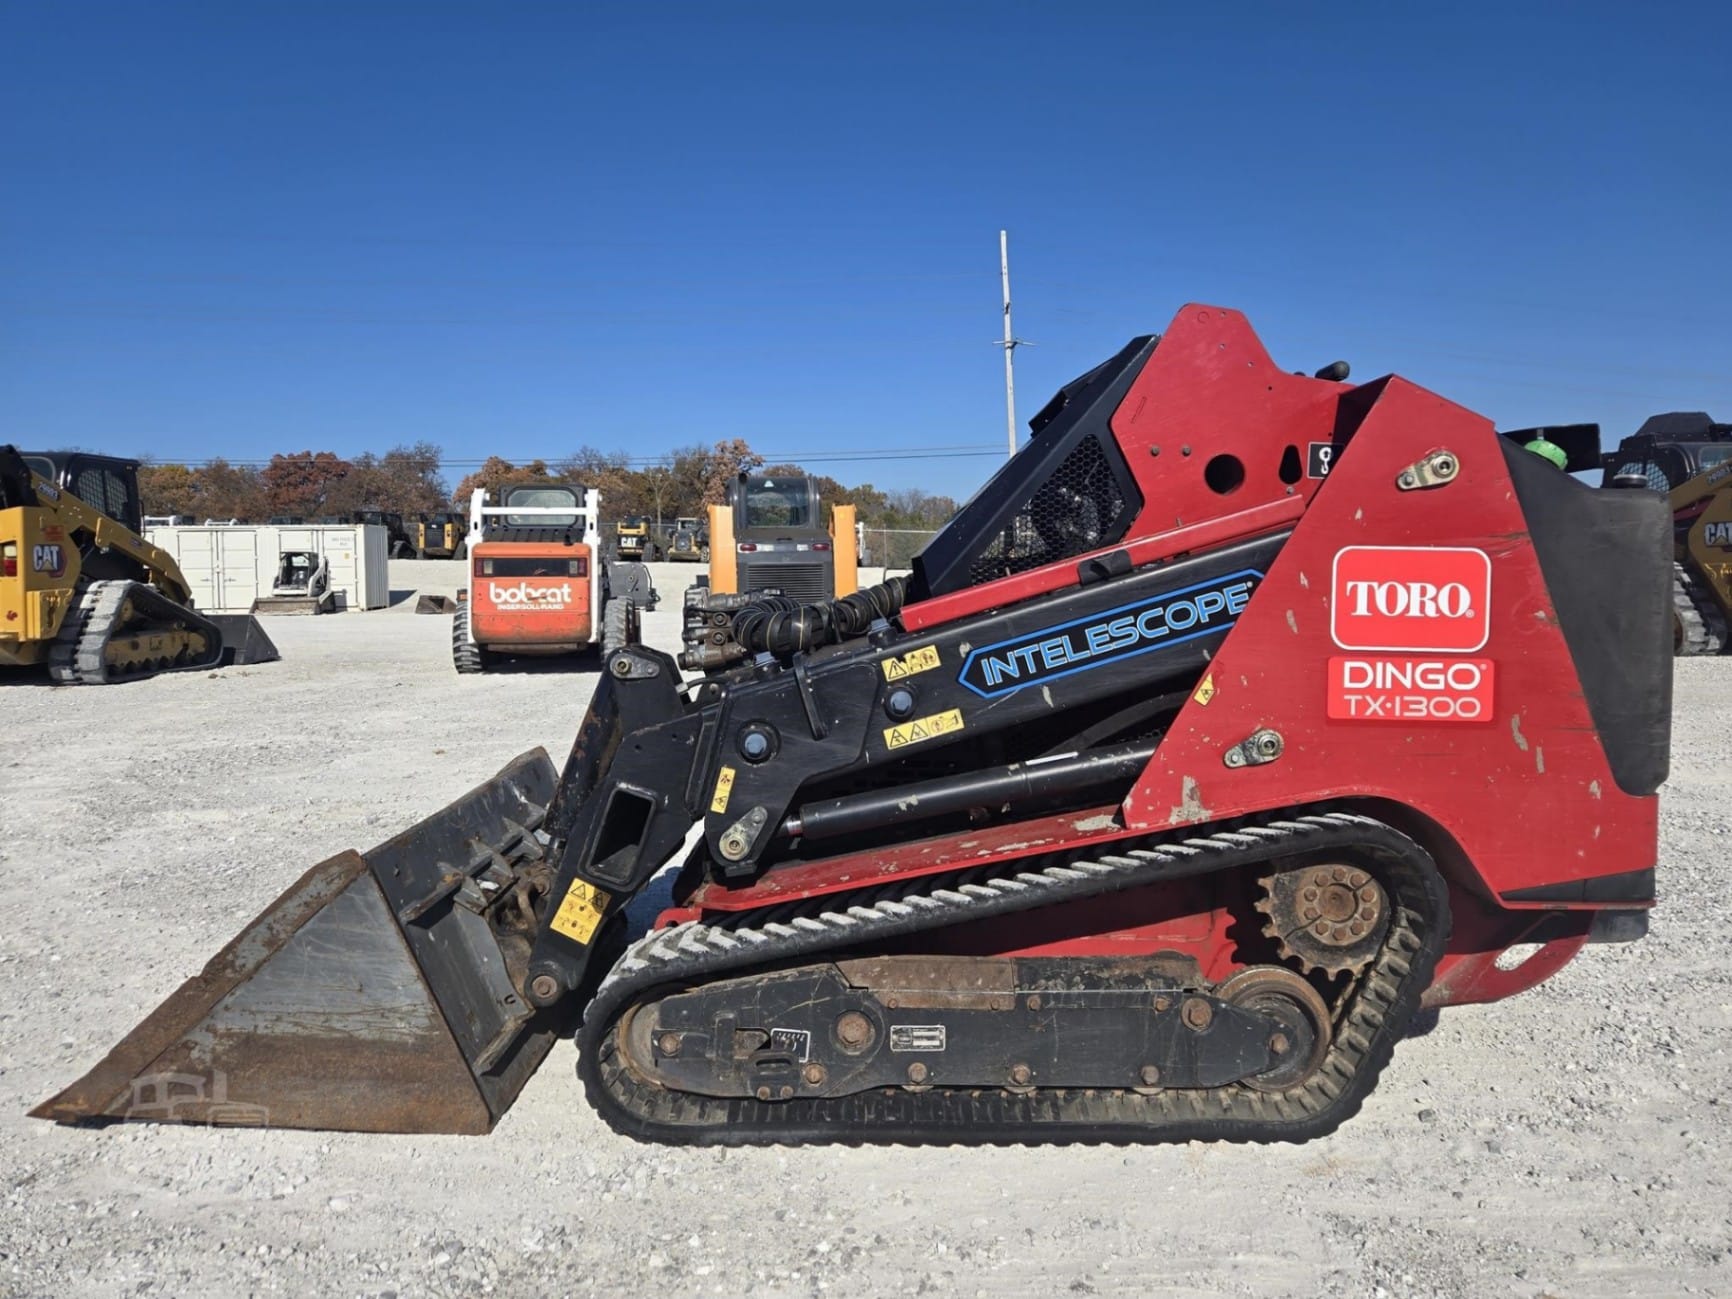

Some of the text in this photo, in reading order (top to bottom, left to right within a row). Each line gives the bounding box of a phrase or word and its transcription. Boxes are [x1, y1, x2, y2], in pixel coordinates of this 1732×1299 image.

[620, 537, 637, 547] CAT
[1704, 522, 1732, 546] CAT
[33, 545, 59, 570] CAT
[489, 582, 572, 603] bobcat
[1346, 581, 1472, 618] TORO
[980, 582, 1250, 686] INTELESCOPE
[1343, 661, 1482, 690] DINGO
